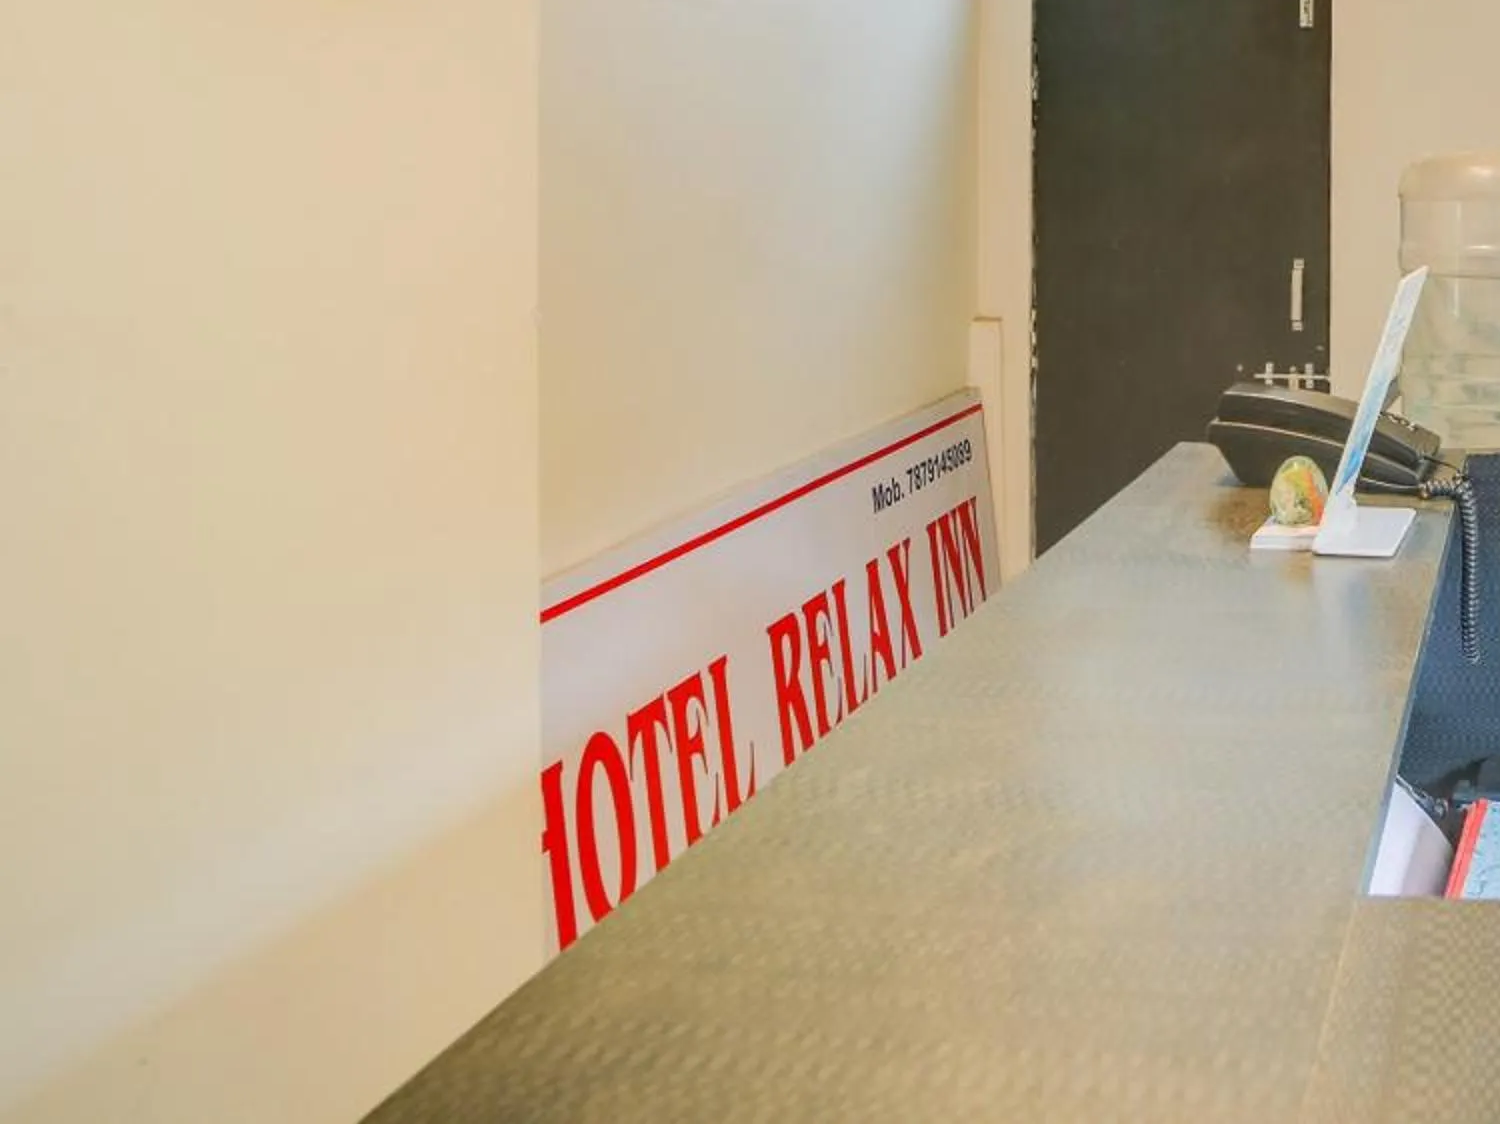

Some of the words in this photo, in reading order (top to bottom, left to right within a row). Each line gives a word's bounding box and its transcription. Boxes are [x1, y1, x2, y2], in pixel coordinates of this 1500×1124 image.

[872, 476, 905, 514] Mob.
[766, 536, 923, 768] RELAX
[926, 495, 988, 639] INN
